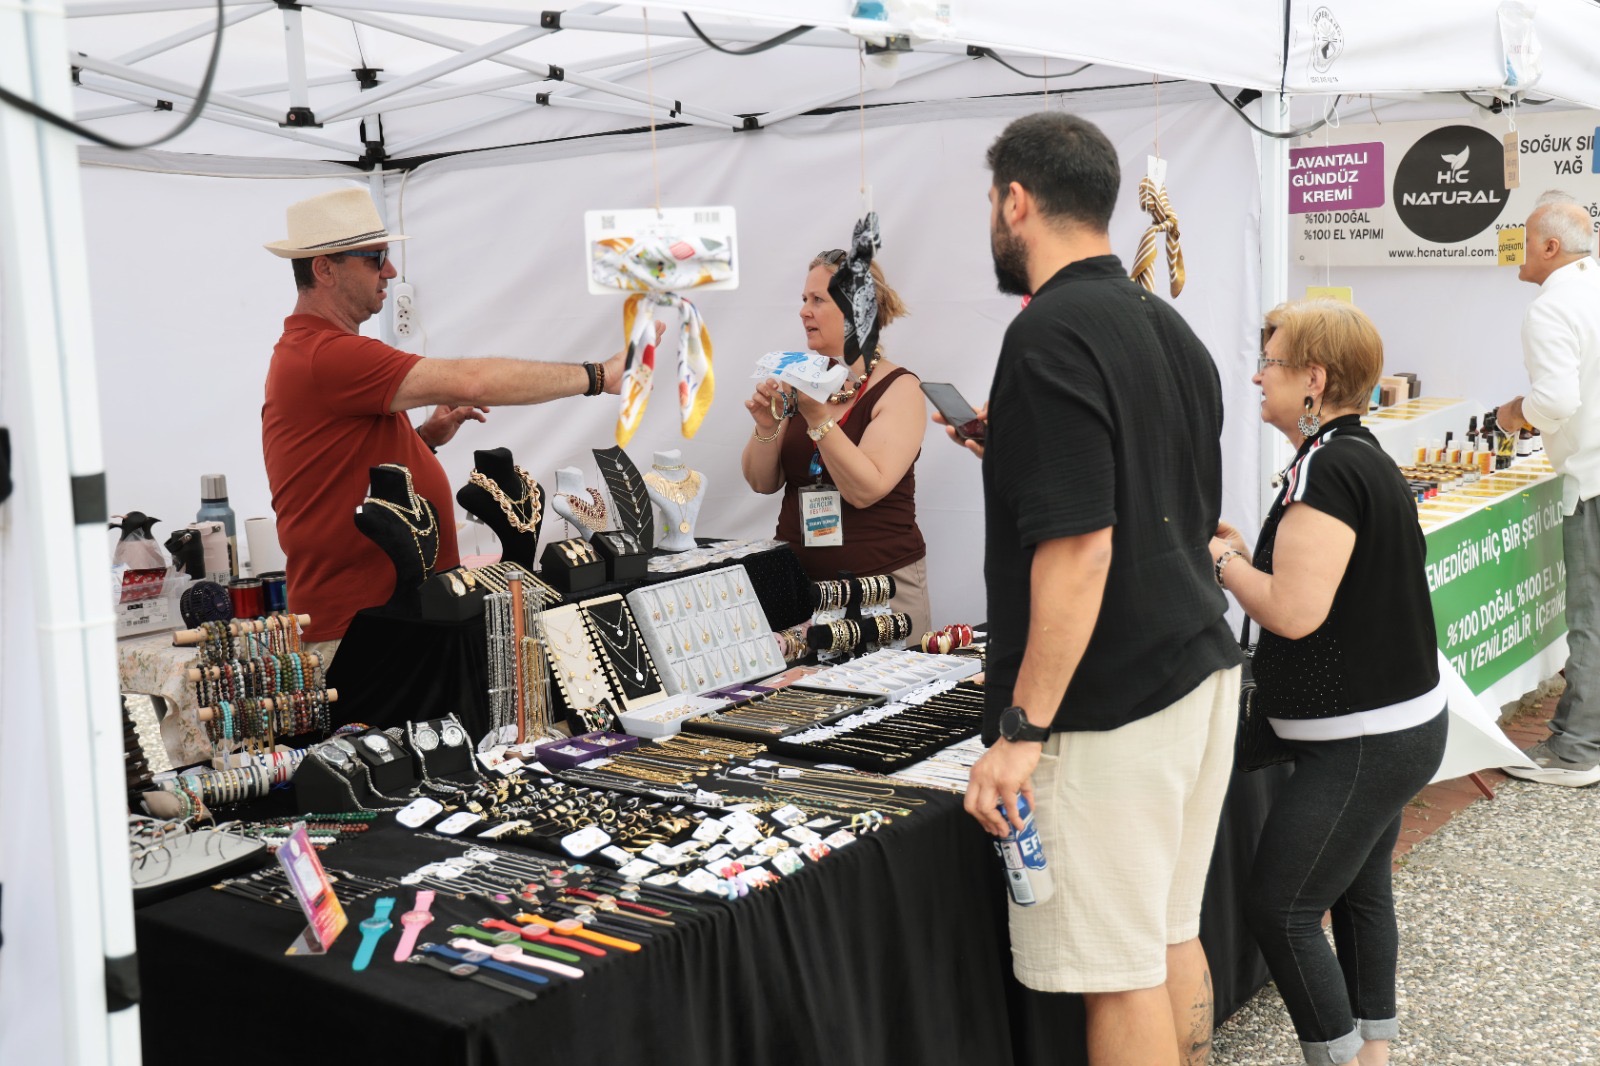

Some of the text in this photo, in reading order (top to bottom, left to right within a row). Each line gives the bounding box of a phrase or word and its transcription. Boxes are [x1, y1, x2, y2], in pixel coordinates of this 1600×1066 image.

[1519, 134, 1572, 154] SOĞUK
[1576, 135, 1594, 151] SI
[1288, 151, 1368, 170] LAVANTALI
[1554, 155, 1583, 175] YAĞ
[1292, 168, 1359, 187] GÜNDÜZ
[1302, 185, 1352, 203] KREMİ
[1402, 189, 1501, 206] NATURAL
[1304, 209, 1371, 224] %100 DOĞAL
[1303, 228, 1384, 241] %100 EL YAPIMI
[1388, 246, 1497, 258] www.hcnatural.com.
[1425, 499, 1564, 593] EMEDİĞİN HİÇ BİR ŞEYİ CİLD
[1446, 610, 1479, 649] %100
[1480, 588, 1515, 632] DOĞAL
[1516, 572, 1541, 608] %100
[1542, 566, 1555, 592] EL
[1471, 610, 1531, 672] YENİLEBİLİR
[1020, 832, 1042, 857] EF
